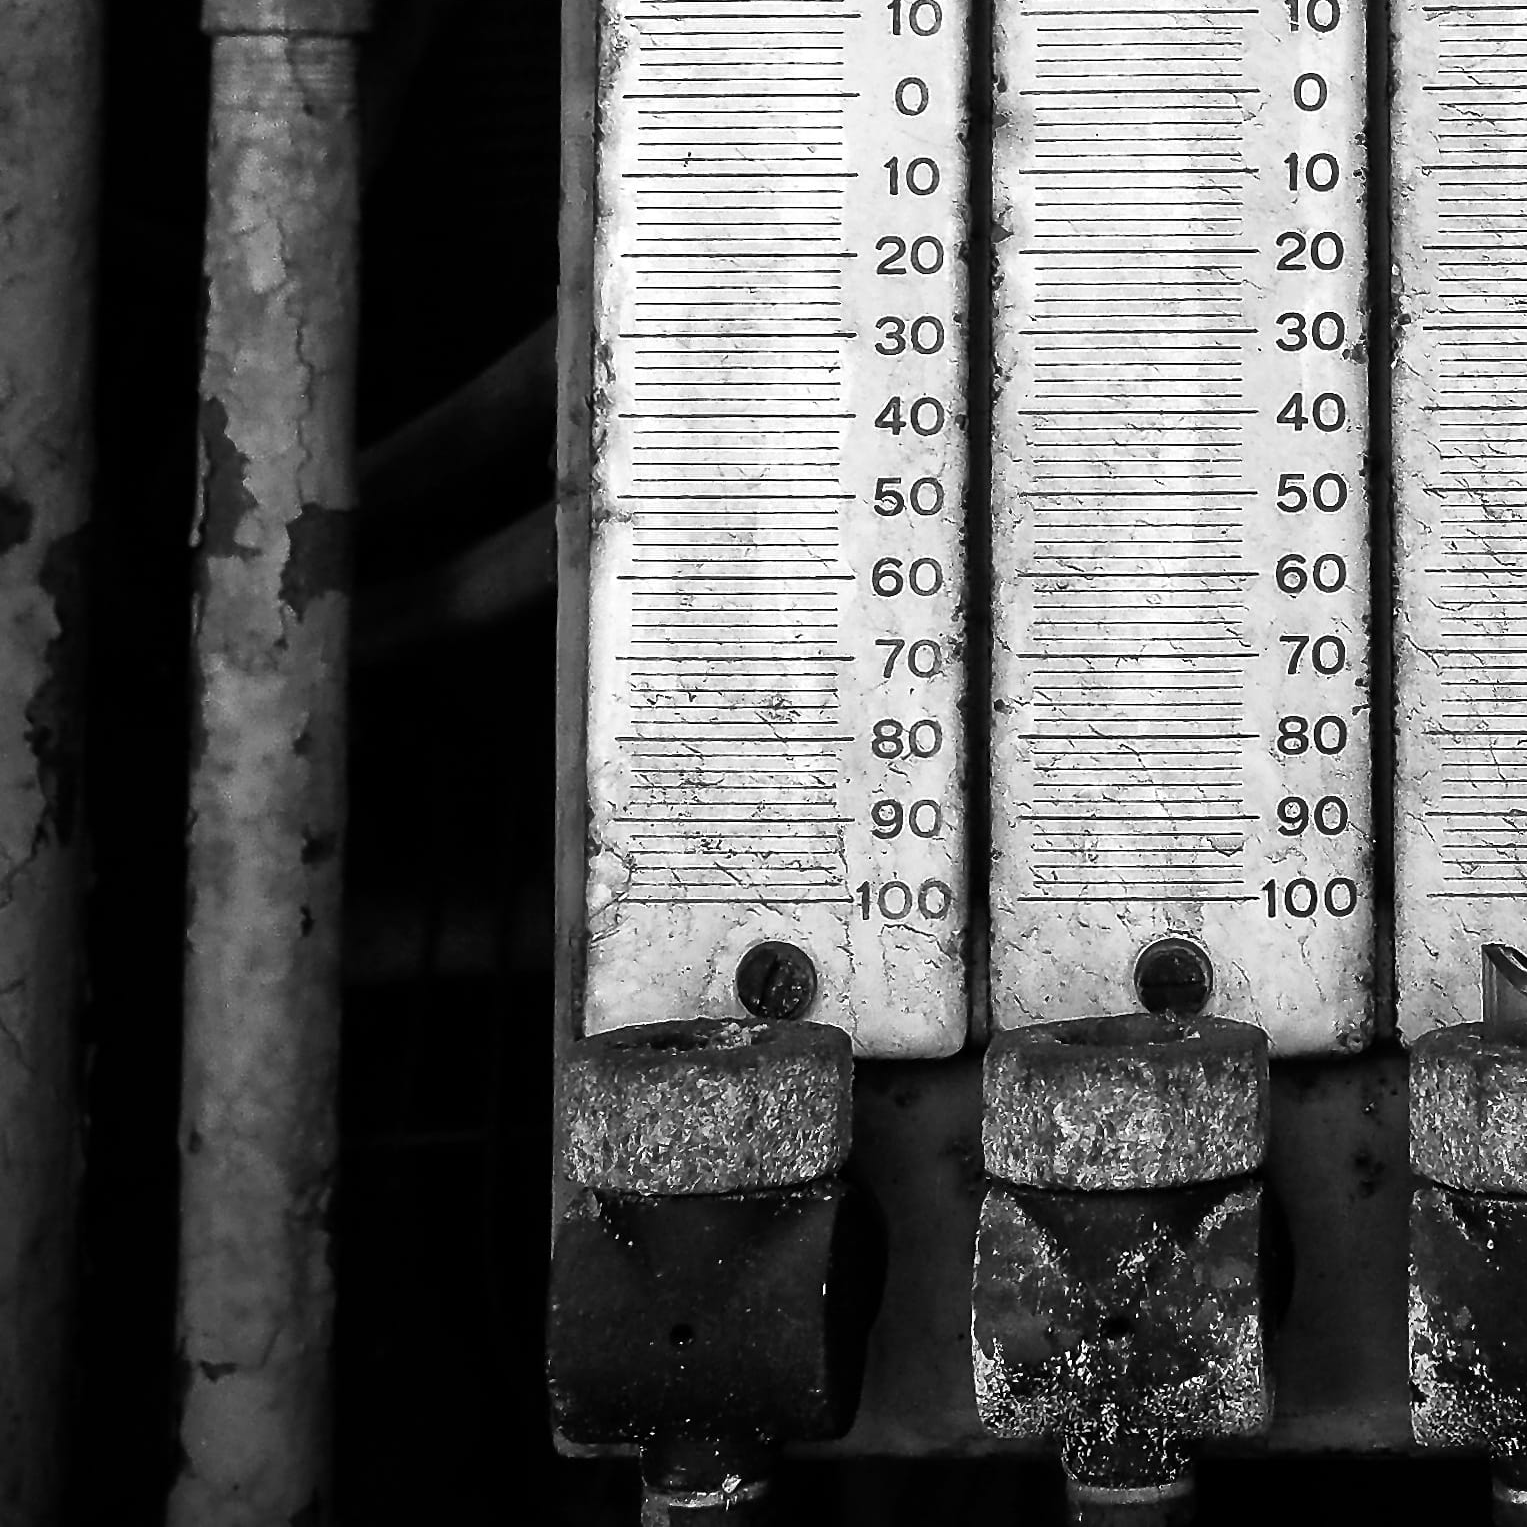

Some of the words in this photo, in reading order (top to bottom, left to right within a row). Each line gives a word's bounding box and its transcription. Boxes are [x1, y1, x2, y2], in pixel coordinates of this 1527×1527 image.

[895, 77, 929, 116] 0
[1293, 73, 1327, 112] 0
[884, 156, 939, 196] 10
[1284, 152, 1339, 192] 10
[877, 236, 947, 275] 20
[1276, 232, 1343, 271] 20
[875, 316, 944, 355] 30
[1276, 312, 1344, 352] 30
[876, 396, 945, 436] 40
[1277, 393, 1345, 432] 40
[875, 477, 944, 516] 50
[1277, 473, 1347, 513] 50
[872, 557, 943, 597] 60
[1276, 554, 1346, 594] 60
[872, 638, 942, 678] 70
[1279, 635, 1345, 675] 70
[871, 718, 941, 758] 80
[1277, 716, 1347, 755] 80
[871, 799, 941, 839] 90
[1277, 796, 1348, 837] 90
[856, 879, 951, 920] 100
[1262, 878, 1356, 918] 100
